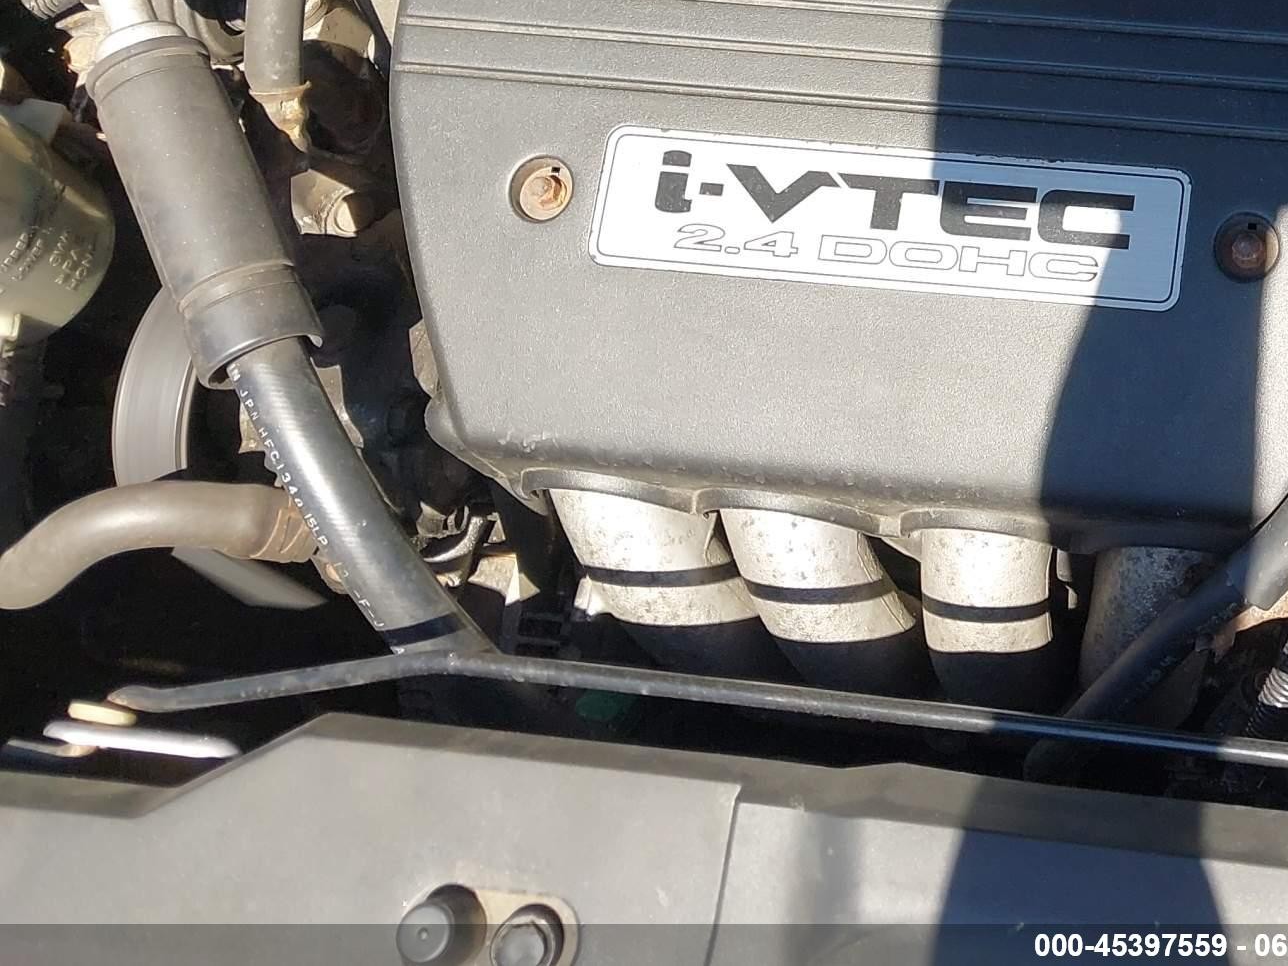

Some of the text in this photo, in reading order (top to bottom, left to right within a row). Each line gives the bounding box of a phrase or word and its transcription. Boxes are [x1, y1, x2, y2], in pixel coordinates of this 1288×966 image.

[653, 149, 1136, 251] i-VTEC
[672, 223, 1099, 283] 2.4 DOHC
